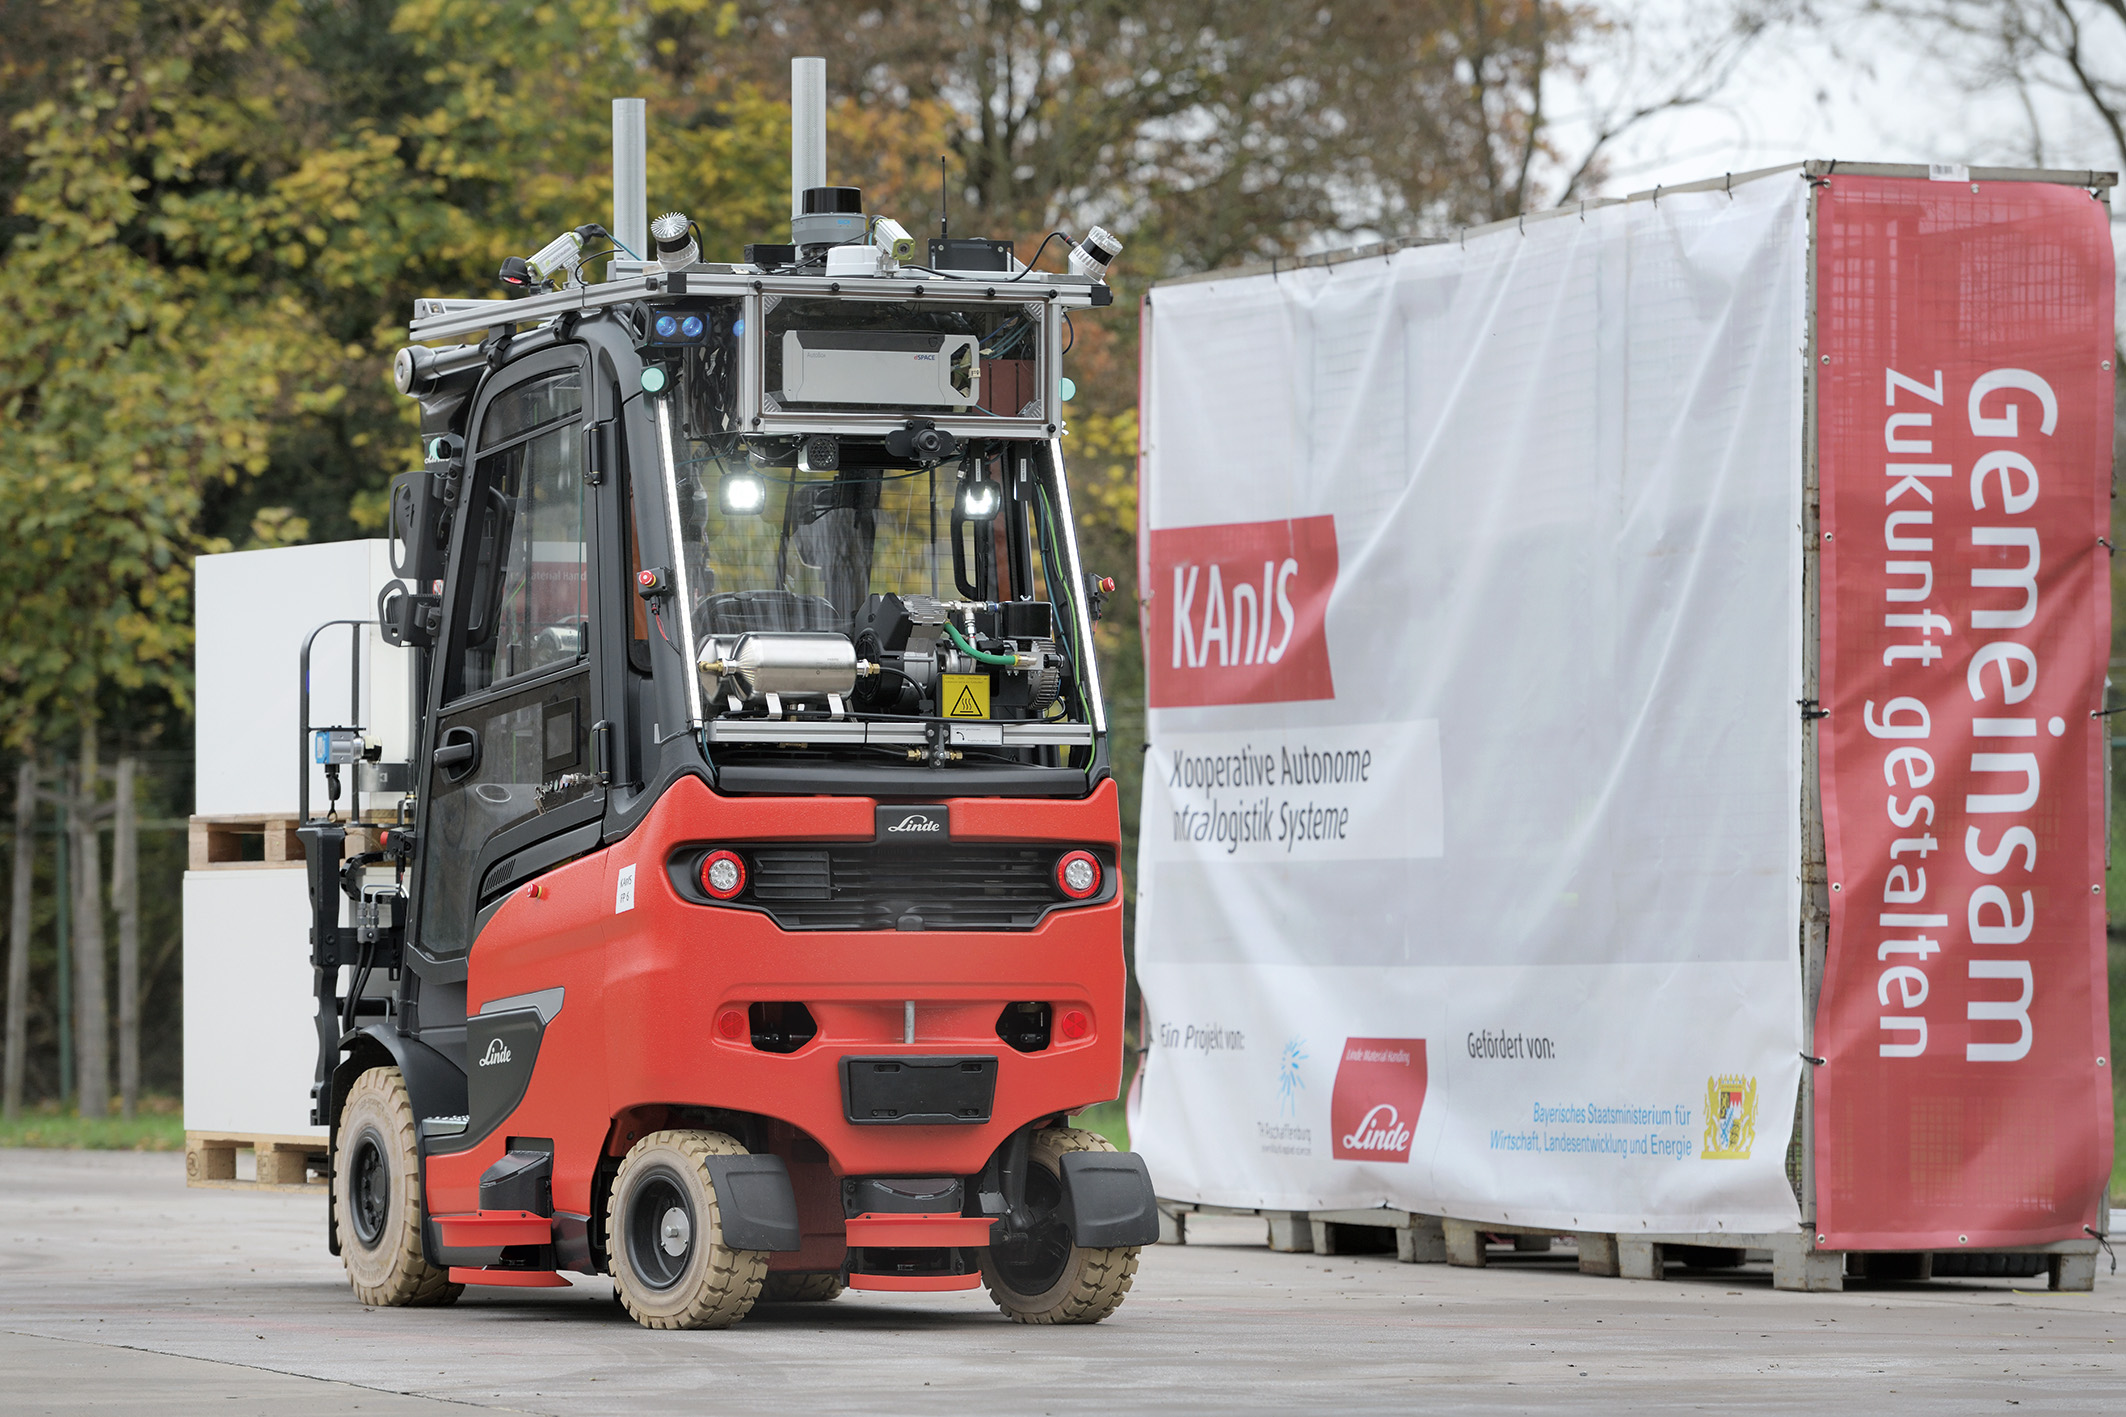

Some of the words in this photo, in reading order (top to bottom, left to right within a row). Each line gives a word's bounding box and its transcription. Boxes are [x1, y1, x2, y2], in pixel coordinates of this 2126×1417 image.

[1882, 367, 1952, 667] Zukunft
[531, 569, 561, 581] aterial
[1172, 557, 1298, 669] KAnIS
[1965, 368, 2066, 1063] Gemeinsam
[1281, 746, 1371, 785] Autonome
[887, 814, 940, 832] Linde
[1173, 797, 1273, 854] ntralogistik
[1278, 801, 1349, 853] Systeme
[1863, 697, 1949, 1058] gestalten
[479, 1038, 512, 1067] Linde
[1161, 1023, 1180, 1048] Ein
[1184, 1022, 1223, 1056] Projekt
[1224, 1030, 1245, 1050] von:
[1467, 1029, 1524, 1059] Gefördert
[1526, 1036, 1556, 1060] von:
[1342, 1103, 1410, 1152] Linde
[1533, 1102, 1586, 1127] Bayerisches
[1587, 1103, 1672, 1126] Staatsministerium
[1675, 1105, 1692, 1126] für
[1490, 1130, 1542, 1154] Wirtschaft,
[1544, 1132, 1628, 1160] Landesentwicklung
[1629, 1135, 1648, 1155] und
[1651, 1134, 1693, 1161] Energie
